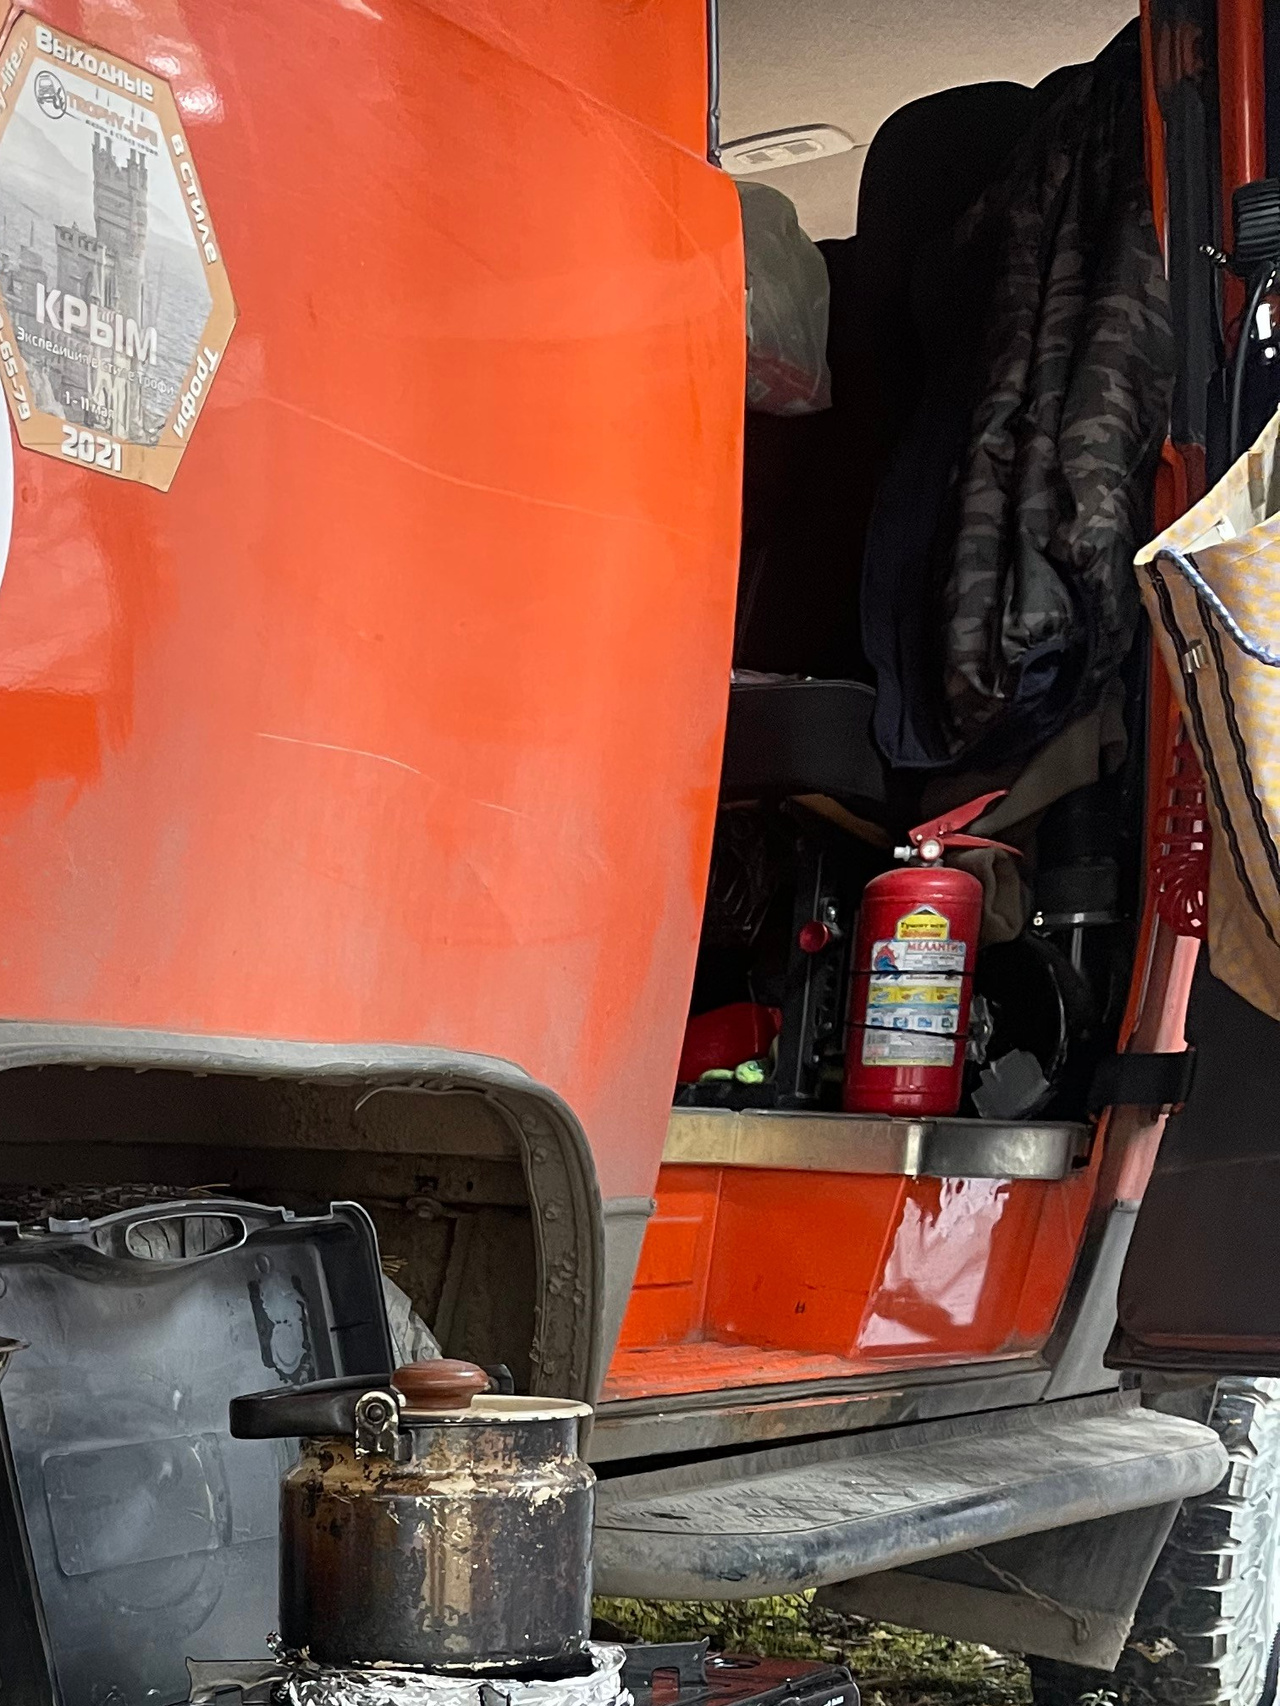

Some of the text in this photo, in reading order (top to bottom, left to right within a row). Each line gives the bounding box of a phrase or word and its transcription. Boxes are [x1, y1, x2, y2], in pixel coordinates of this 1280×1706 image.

[35, 25, 154, 102] Выходные
[17, 326, 89, 365] Экспедиция
[102, 363, 134, 381] стие
[36, 282, 157, 366] КРЫМ
[172, 347, 219, 439] Трофи
[61, 424, 124, 472] 2021
